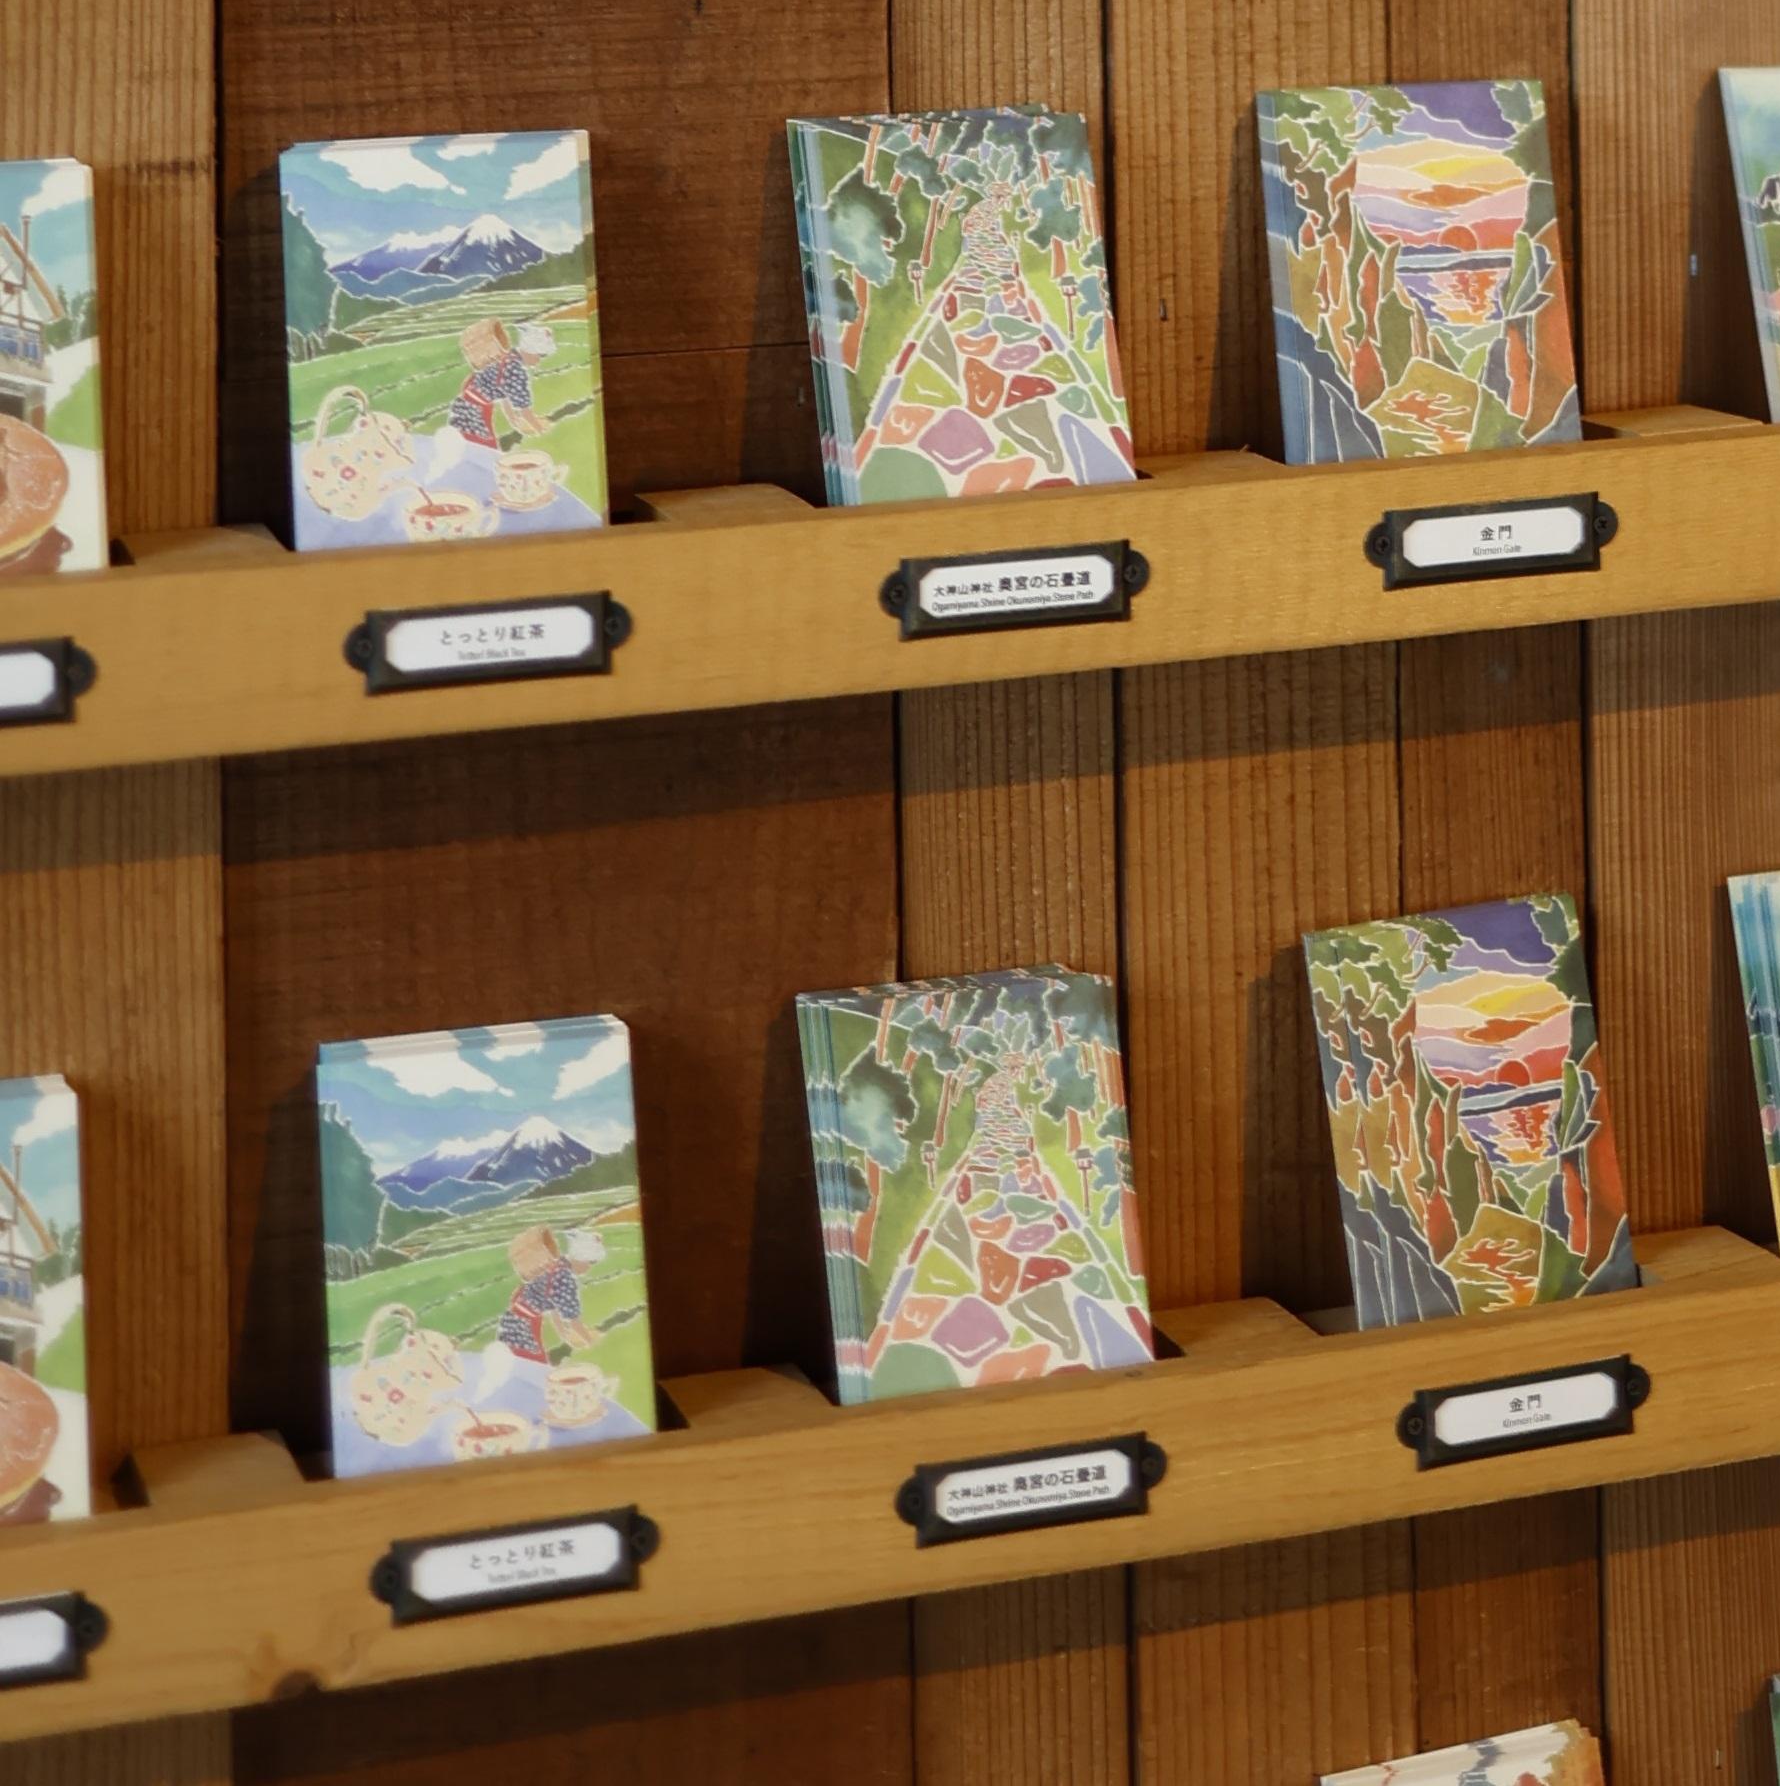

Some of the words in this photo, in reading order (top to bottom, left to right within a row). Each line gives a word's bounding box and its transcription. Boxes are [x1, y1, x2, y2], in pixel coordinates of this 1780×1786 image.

[1479, 524, 1513, 543] 金門
[440, 622, 546, 646] とっとり紅茶
[1508, 1392, 1543, 1413] 金門
[469, 1538, 576, 1570] とっとり紅茶
